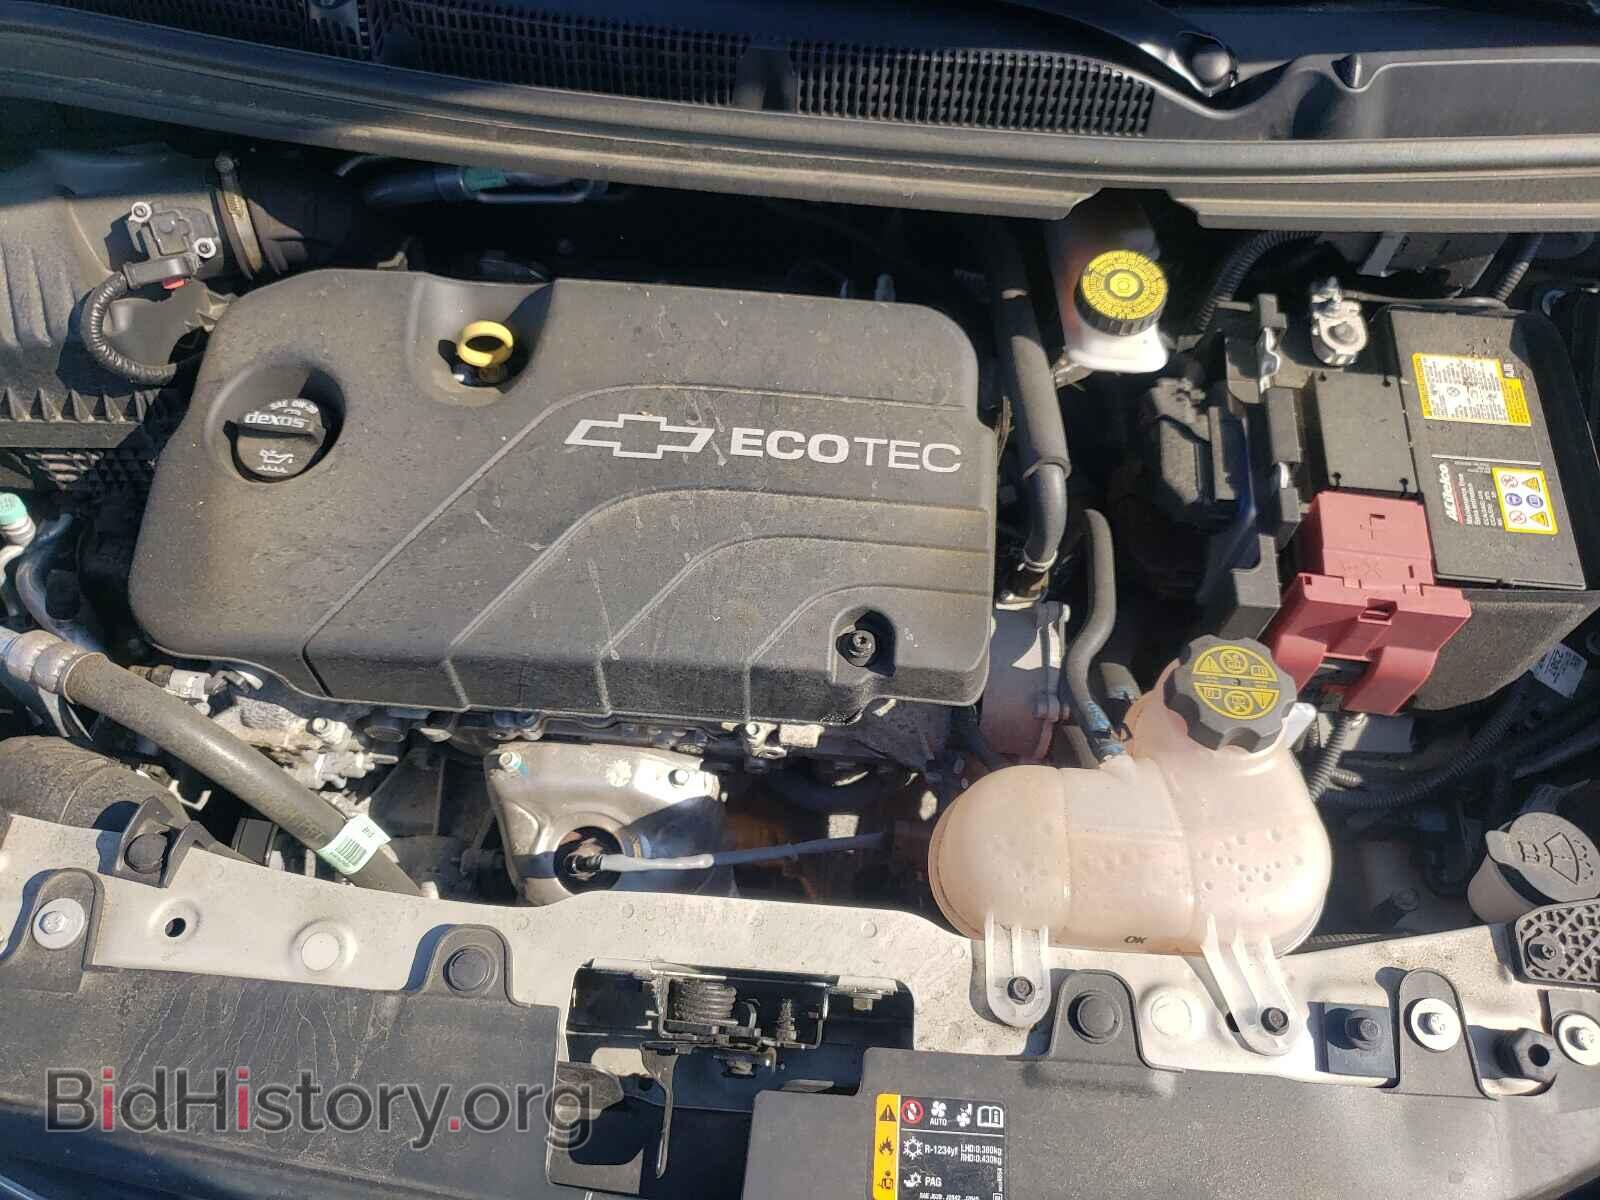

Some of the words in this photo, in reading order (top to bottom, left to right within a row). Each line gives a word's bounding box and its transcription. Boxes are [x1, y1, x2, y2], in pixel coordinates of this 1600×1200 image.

[244, 410, 305, 429] dexos
[730, 427, 962, 473] ECOTEC
[1438, 463, 1459, 522] ACDelco
[1124, 935, 1148, 945] OK
[929, 1117, 948, 1126] AUTO
[924, 1144, 958, 1158] R-1234yf
[924, 1176, 943, 1187] PAG
